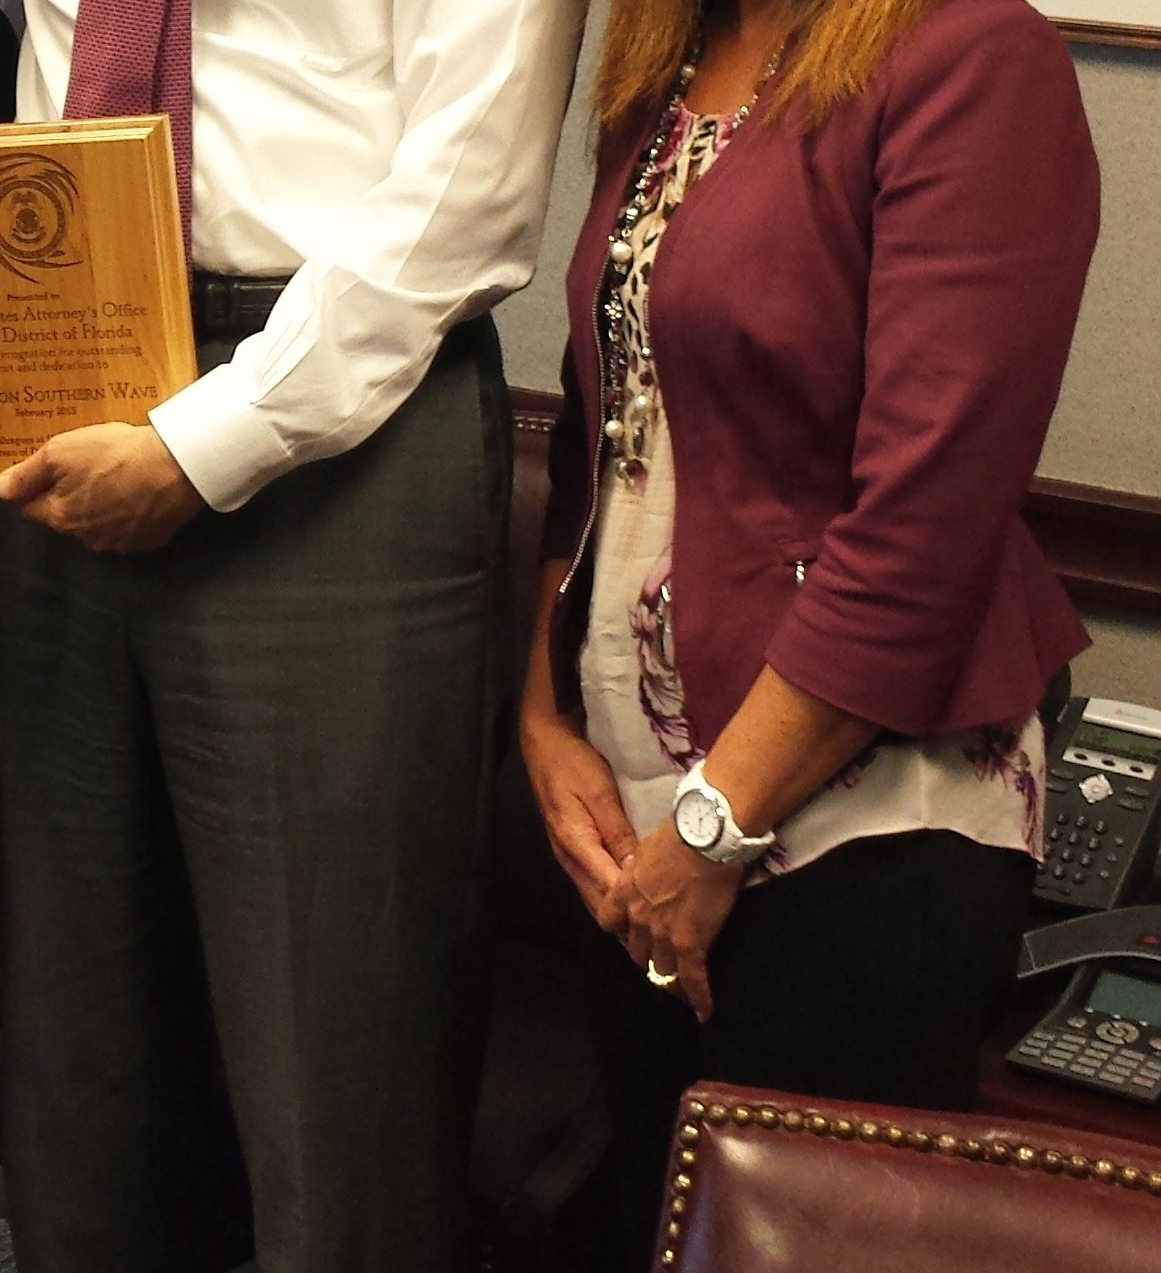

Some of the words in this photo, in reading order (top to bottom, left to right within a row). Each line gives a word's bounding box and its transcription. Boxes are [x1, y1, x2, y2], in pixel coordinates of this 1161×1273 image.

[23, 305, 98, 323] Attorney's
[102, 301, 147, 317] Office
[1, 326, 58, 344] District
[82, 323, 133, 339] Florida
[17, 361, 37, 372] and
[23, 385, 105, 403] SOUTHERN
[108, 382, 158, 399] WAVE
[15, 408, 53, 419] February
